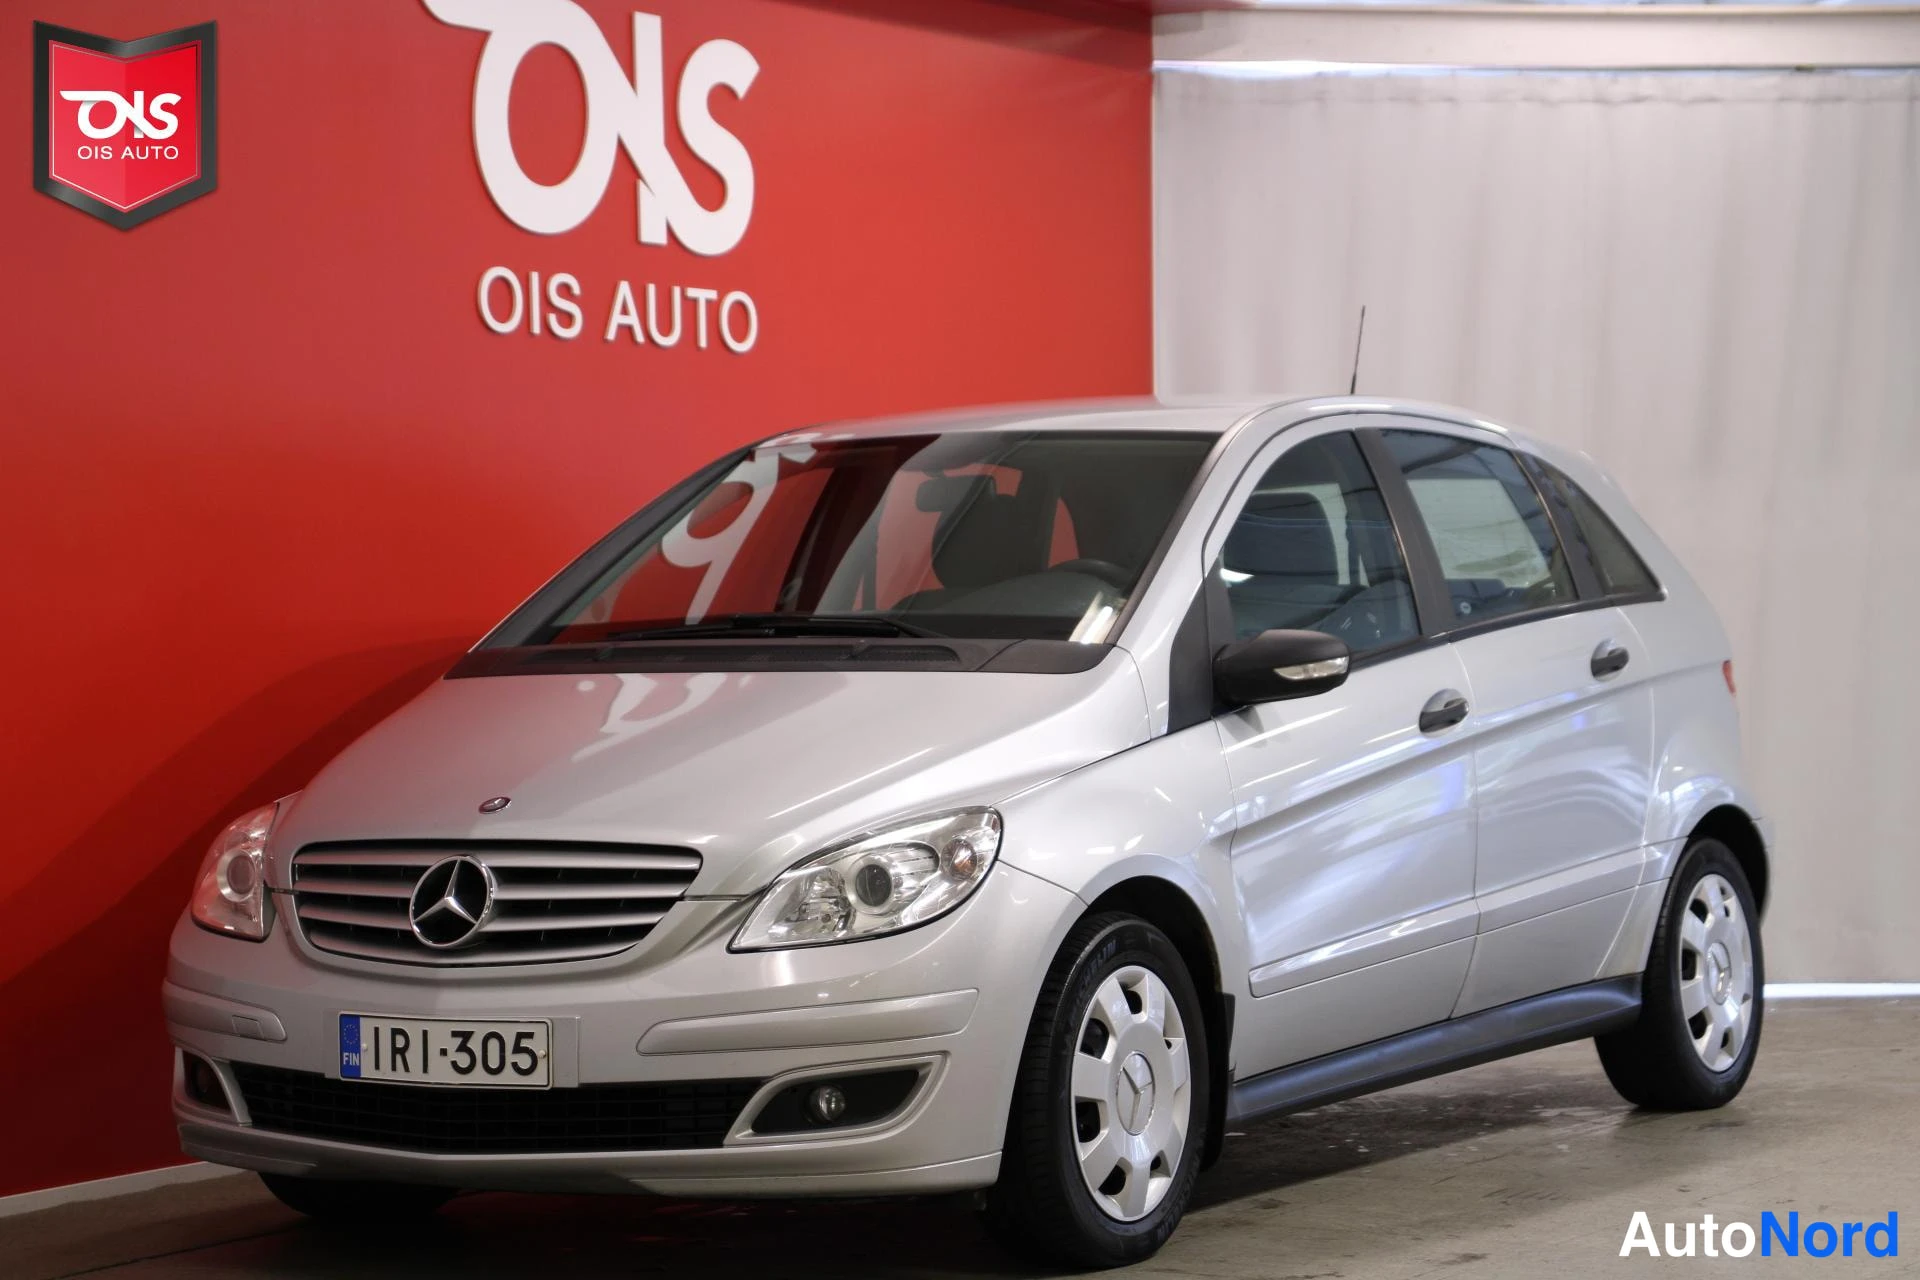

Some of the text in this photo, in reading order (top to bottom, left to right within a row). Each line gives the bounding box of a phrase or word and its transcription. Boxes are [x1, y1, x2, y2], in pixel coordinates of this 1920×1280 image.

[477, 266, 759, 354] OIS AUTO
[343, 1052, 360, 1066] FIN
[373, 1026, 539, 1077] IRI-305
